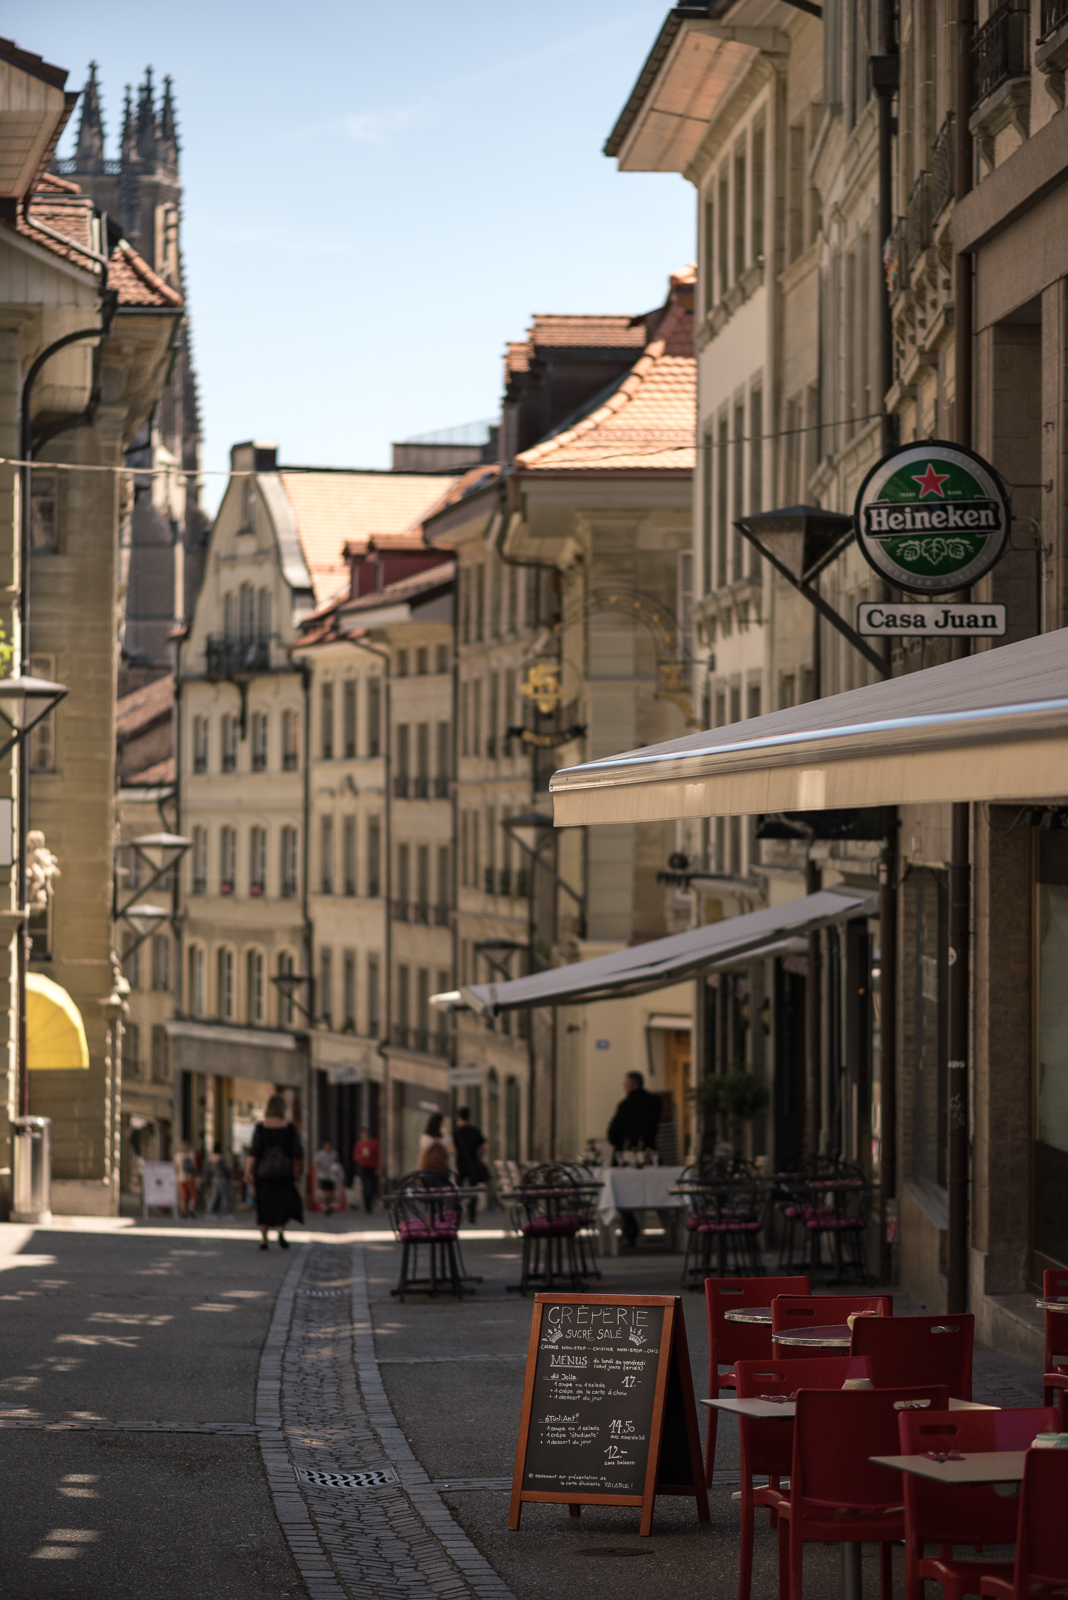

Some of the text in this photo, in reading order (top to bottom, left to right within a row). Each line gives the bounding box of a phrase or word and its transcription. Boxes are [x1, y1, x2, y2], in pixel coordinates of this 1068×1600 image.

[869, 505, 996, 531] Heineken
[866, 609, 998, 628] Casa Juan
[596, 1327, 623, 1340] SALÉ
